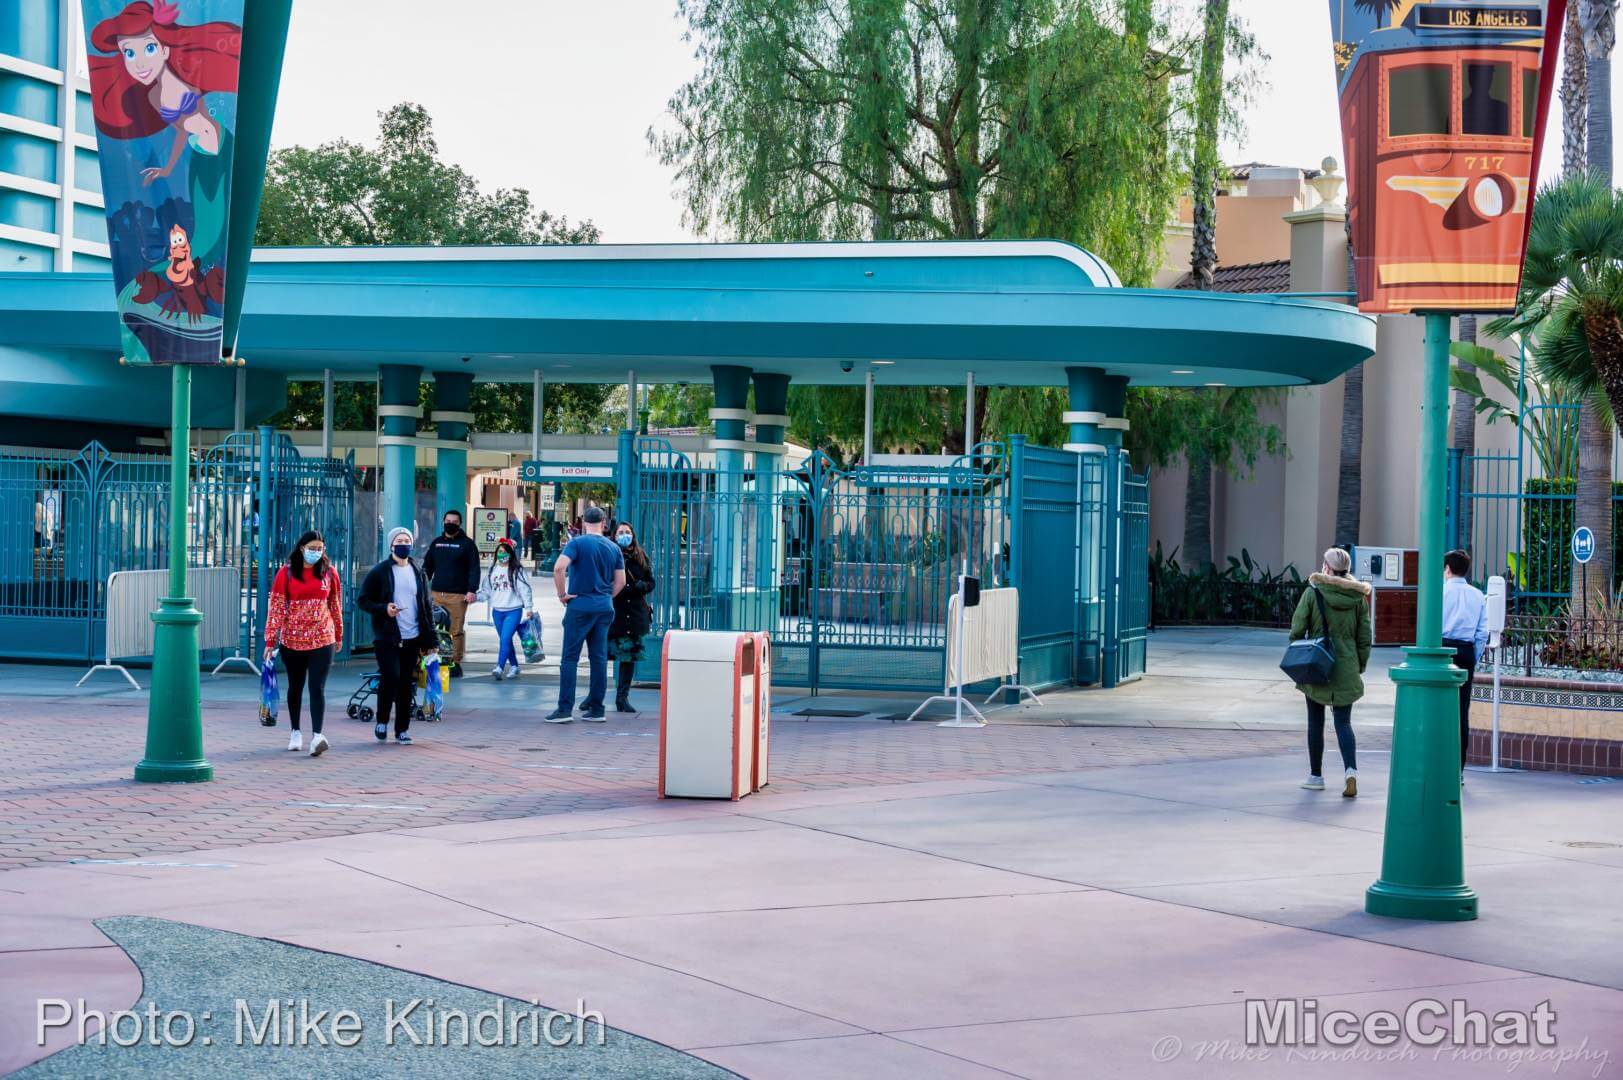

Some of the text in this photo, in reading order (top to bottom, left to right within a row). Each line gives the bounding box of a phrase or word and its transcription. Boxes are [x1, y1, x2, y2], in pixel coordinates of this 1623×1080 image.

[1449, 9, 1528, 26] LOS ANGELES
[1464, 155, 1505, 170] 717
[574, 467, 590, 475] Only
